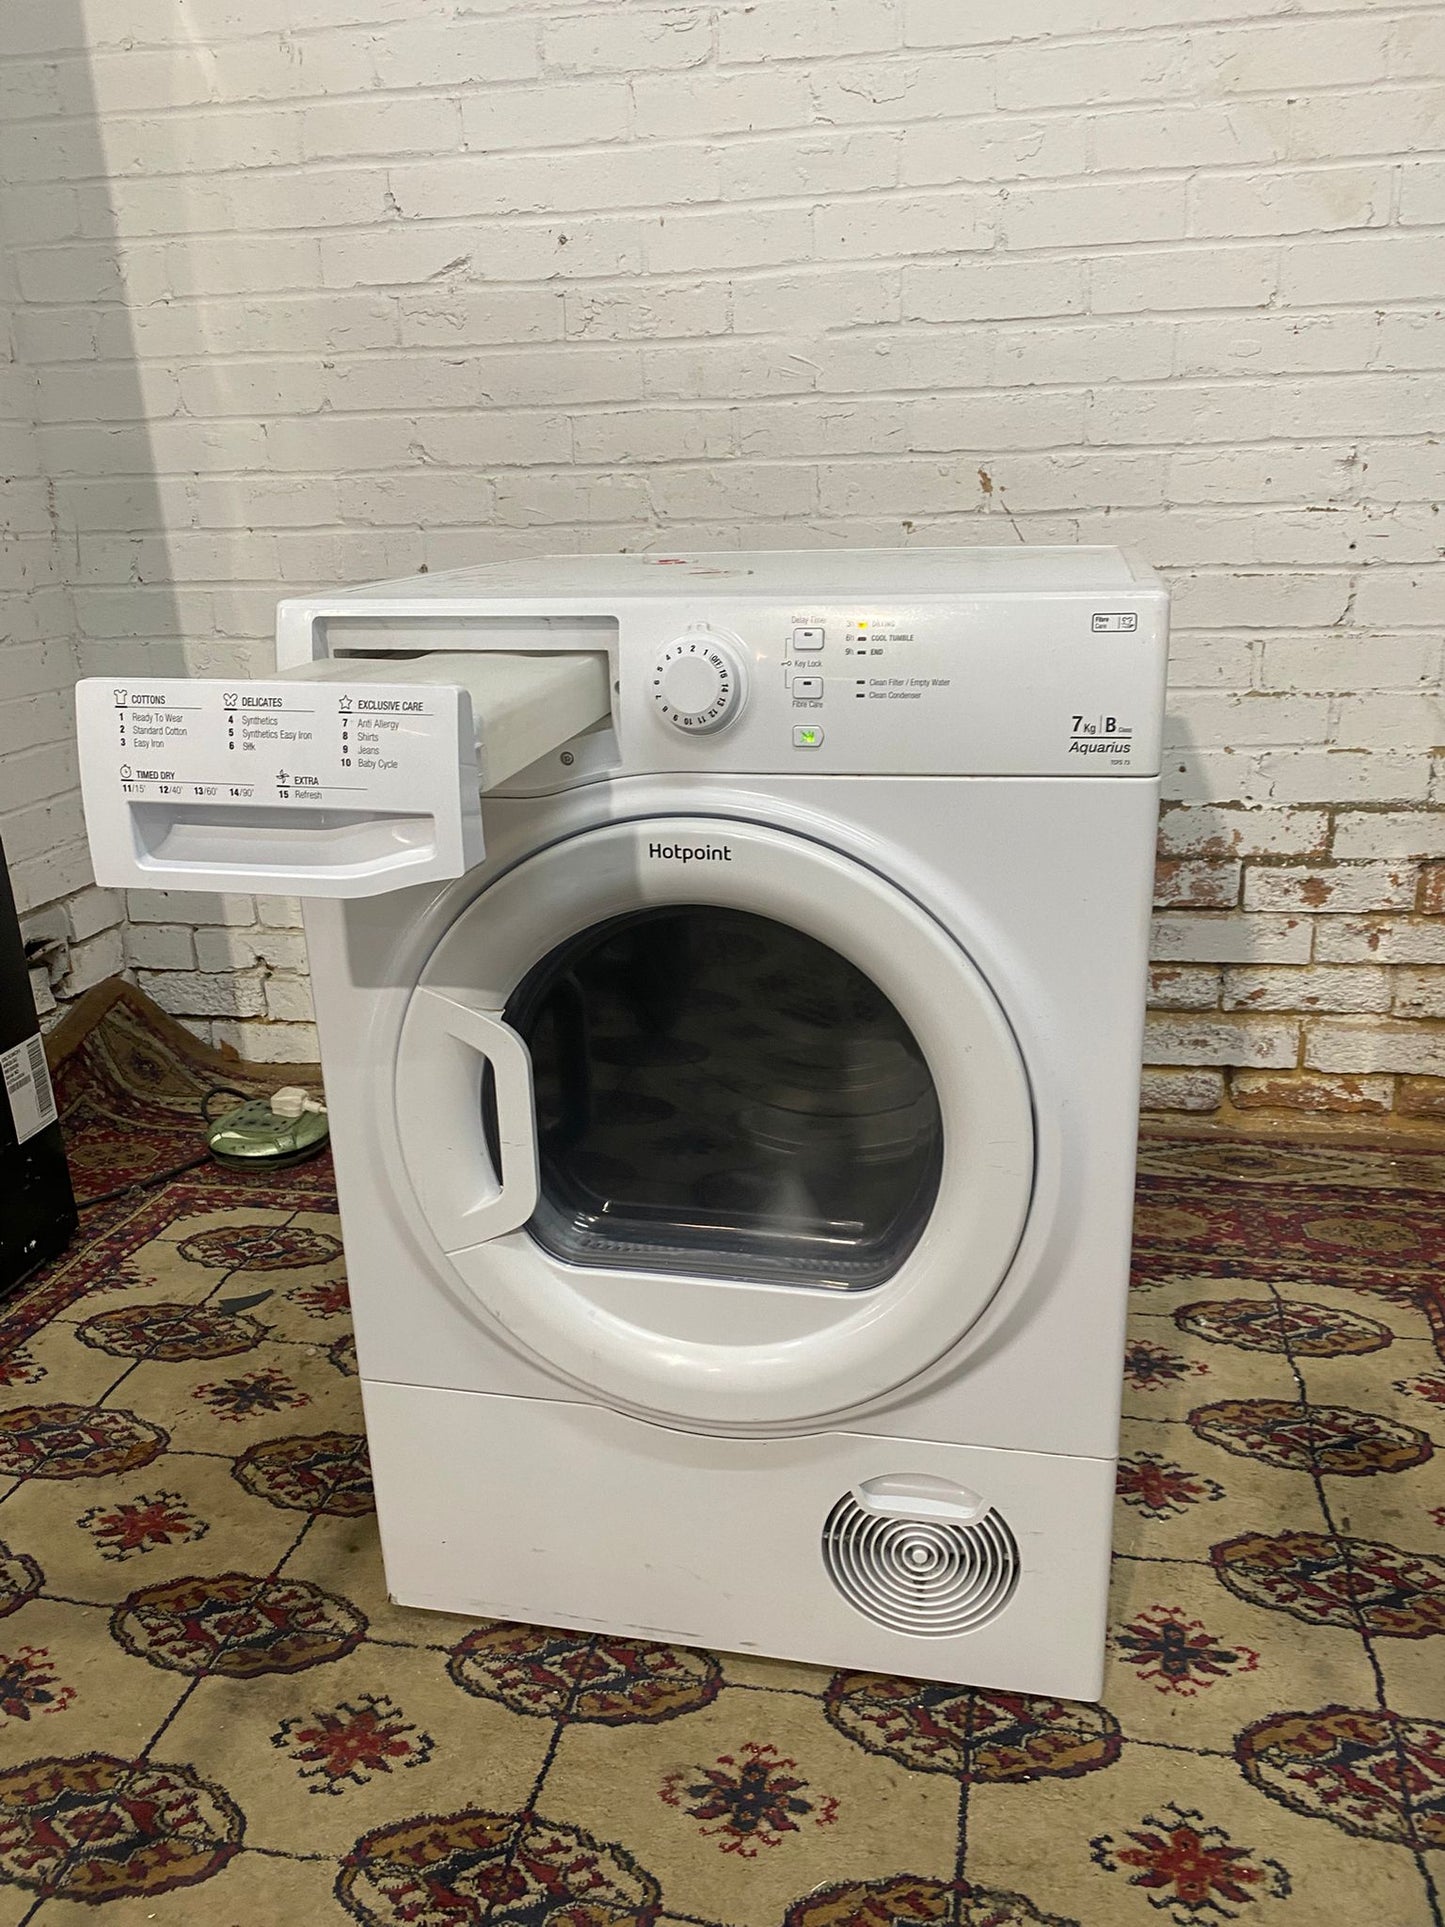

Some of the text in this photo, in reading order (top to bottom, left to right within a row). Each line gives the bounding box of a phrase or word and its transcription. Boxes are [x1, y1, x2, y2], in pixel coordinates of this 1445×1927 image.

[794, 660, 806, 668] Key
[721, 683, 728, 692] 14
[911, 679, 930, 687] Empty
[132, 694, 166, 705] COTTONS
[242, 697, 282, 708] DELICATES
[716, 697, 726, 707] 13
[358, 700, 424, 712] EXCLUSIVE CARE
[119, 713, 183, 723] 1 Ready To Wear
[708, 708, 718, 718] 12
[228, 716, 278, 726] 4 Synthetics
[342, 718, 399, 730] 7 Anti Allergy
[1105, 717, 1117, 732] B
[120, 725, 187, 735] 2 Standard Cotton
[229, 728, 312, 741] 5 Synthetics Easy Iron
[342, 732, 379, 742] 8 Shirts
[120, 738, 164, 748] 3 Easy Iron
[229, 742, 256, 751] 6 Silk
[343, 745, 380, 755] 9 Jeans
[1068, 742, 1131, 755] Aquarius
[341, 758, 398, 769] 10 Baby Cycle
[136, 770, 175, 780] TIMED DRY
[294, 776, 319, 785] EXTRA
[279, 790, 322, 799] 15 Refresh
[649, 843, 732, 863] Hotpoint
